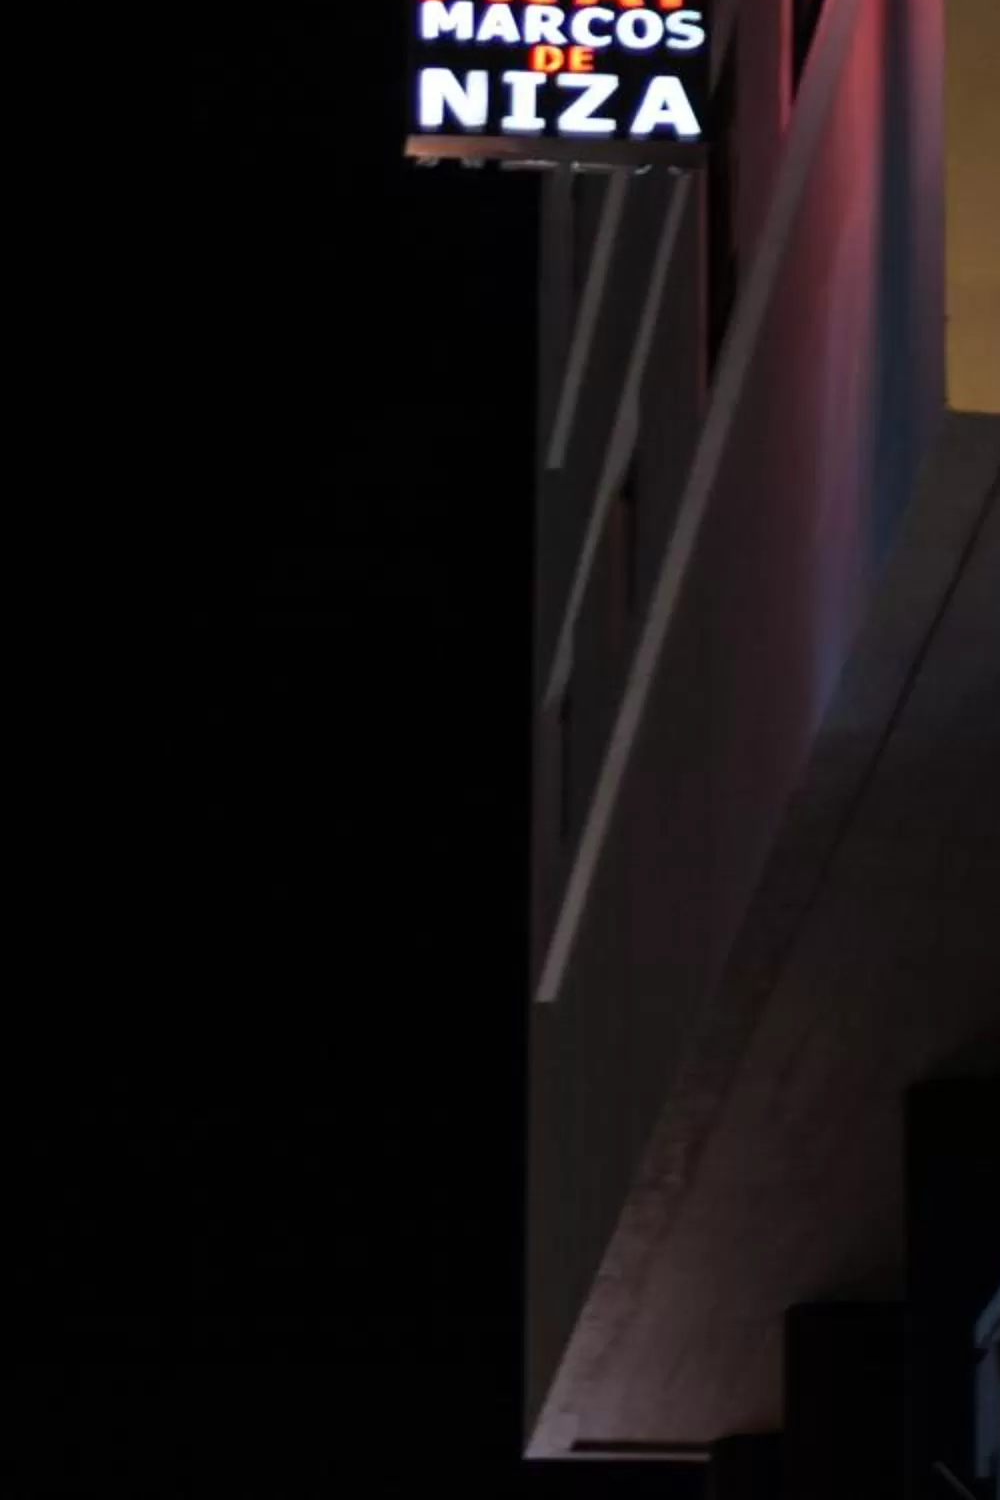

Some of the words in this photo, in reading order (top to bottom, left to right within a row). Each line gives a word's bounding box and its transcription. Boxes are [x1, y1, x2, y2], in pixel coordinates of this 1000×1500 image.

[420, 0, 706, 50] MARCOS
[531, 45, 595, 73] DE
[418, 67, 702, 136] NIZA
